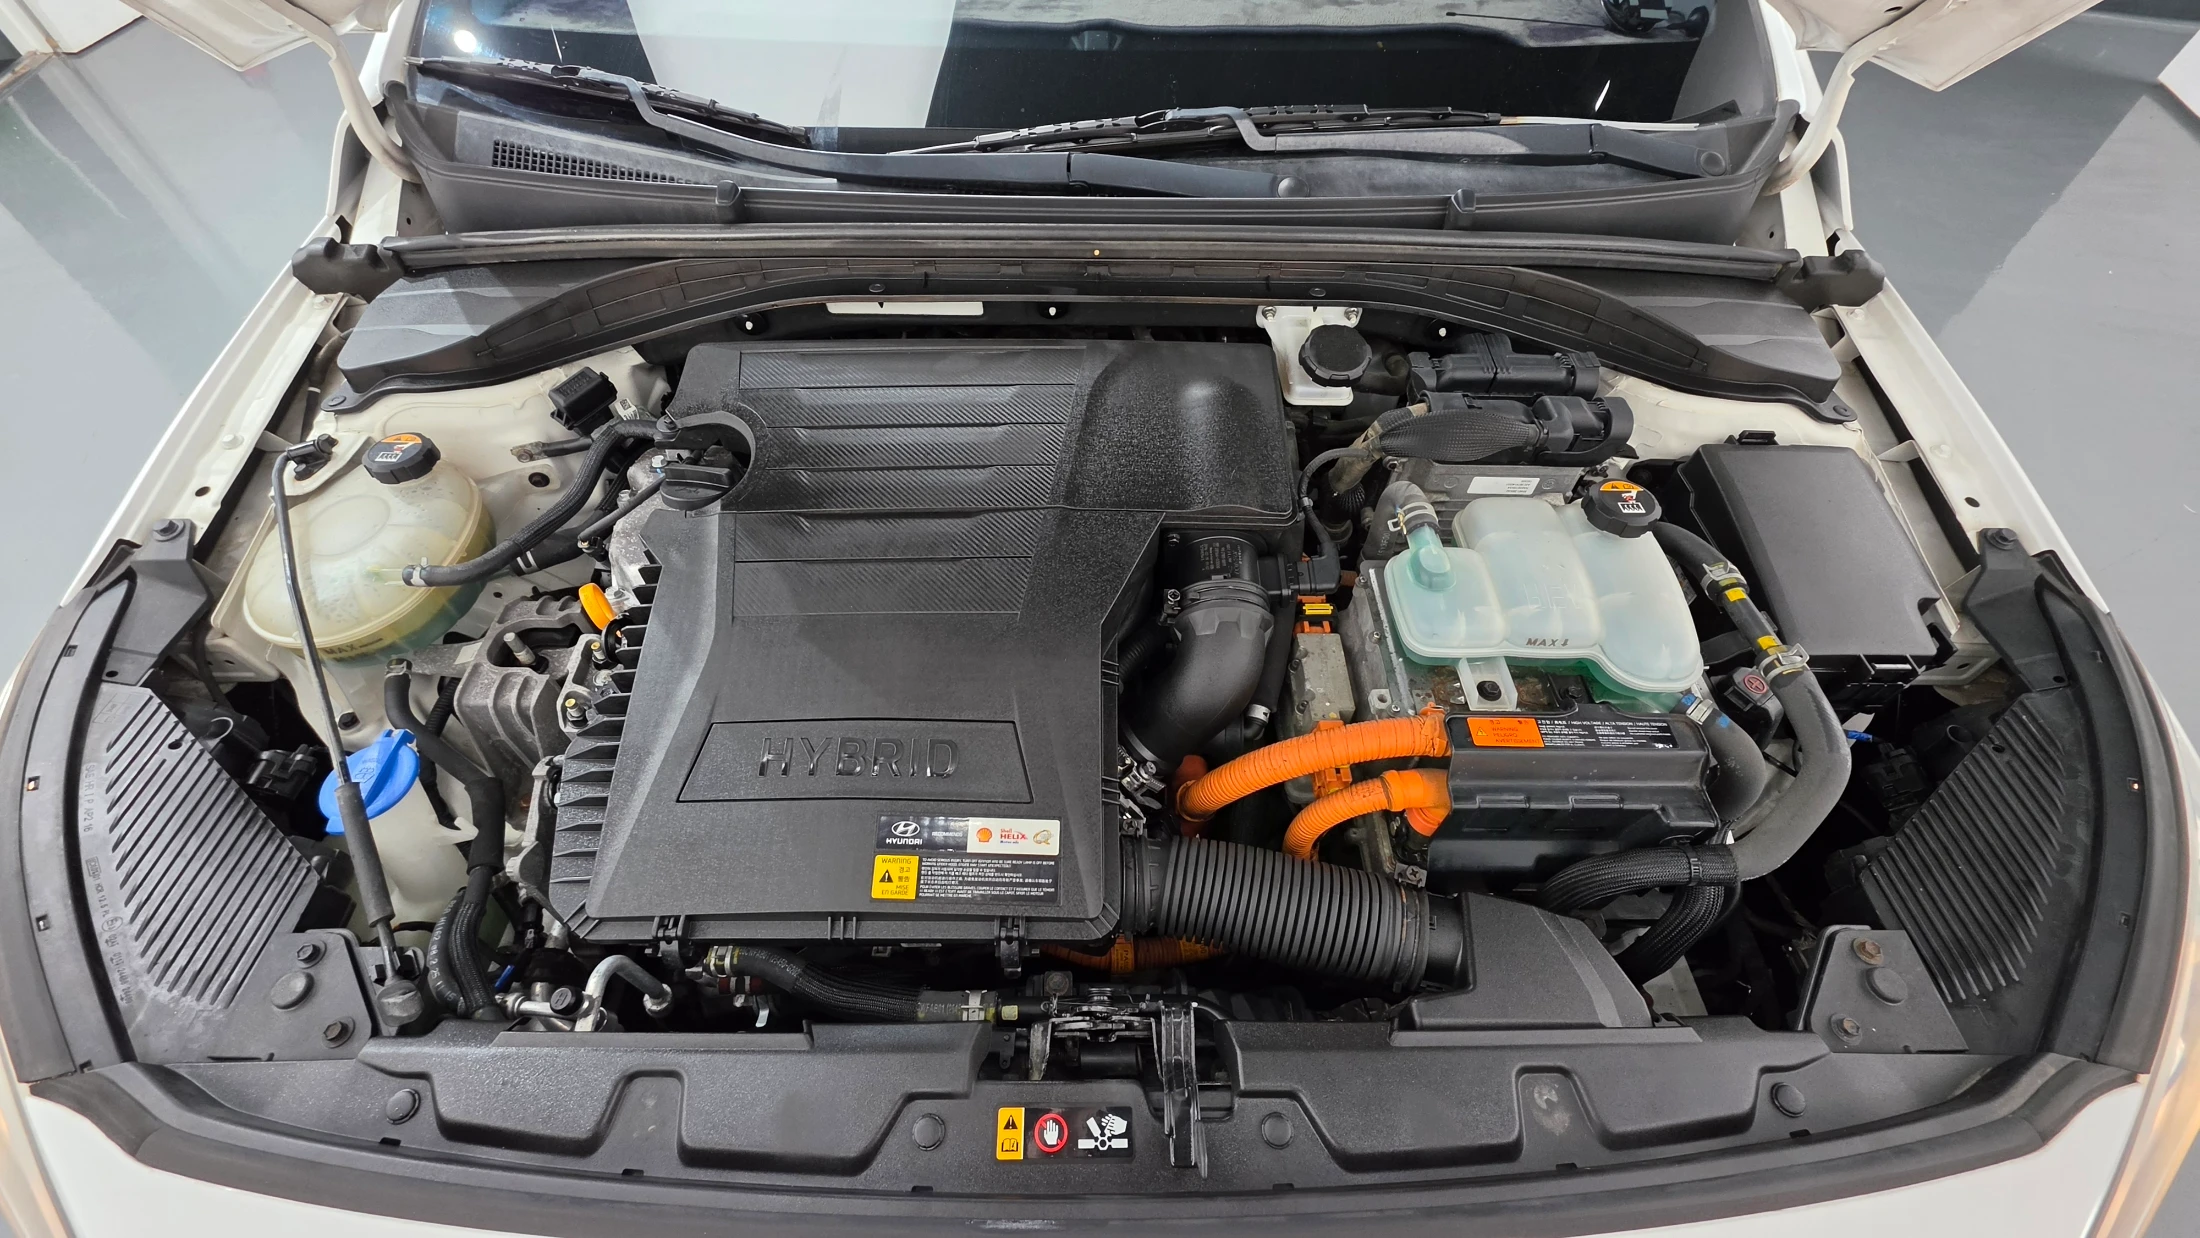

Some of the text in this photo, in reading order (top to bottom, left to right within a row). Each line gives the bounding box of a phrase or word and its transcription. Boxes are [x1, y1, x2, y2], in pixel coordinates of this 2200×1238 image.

[1526, 638, 1558, 646] MAX
[323, 644, 358, 654] MAX
[758, 737, 958, 778] HYBRID
